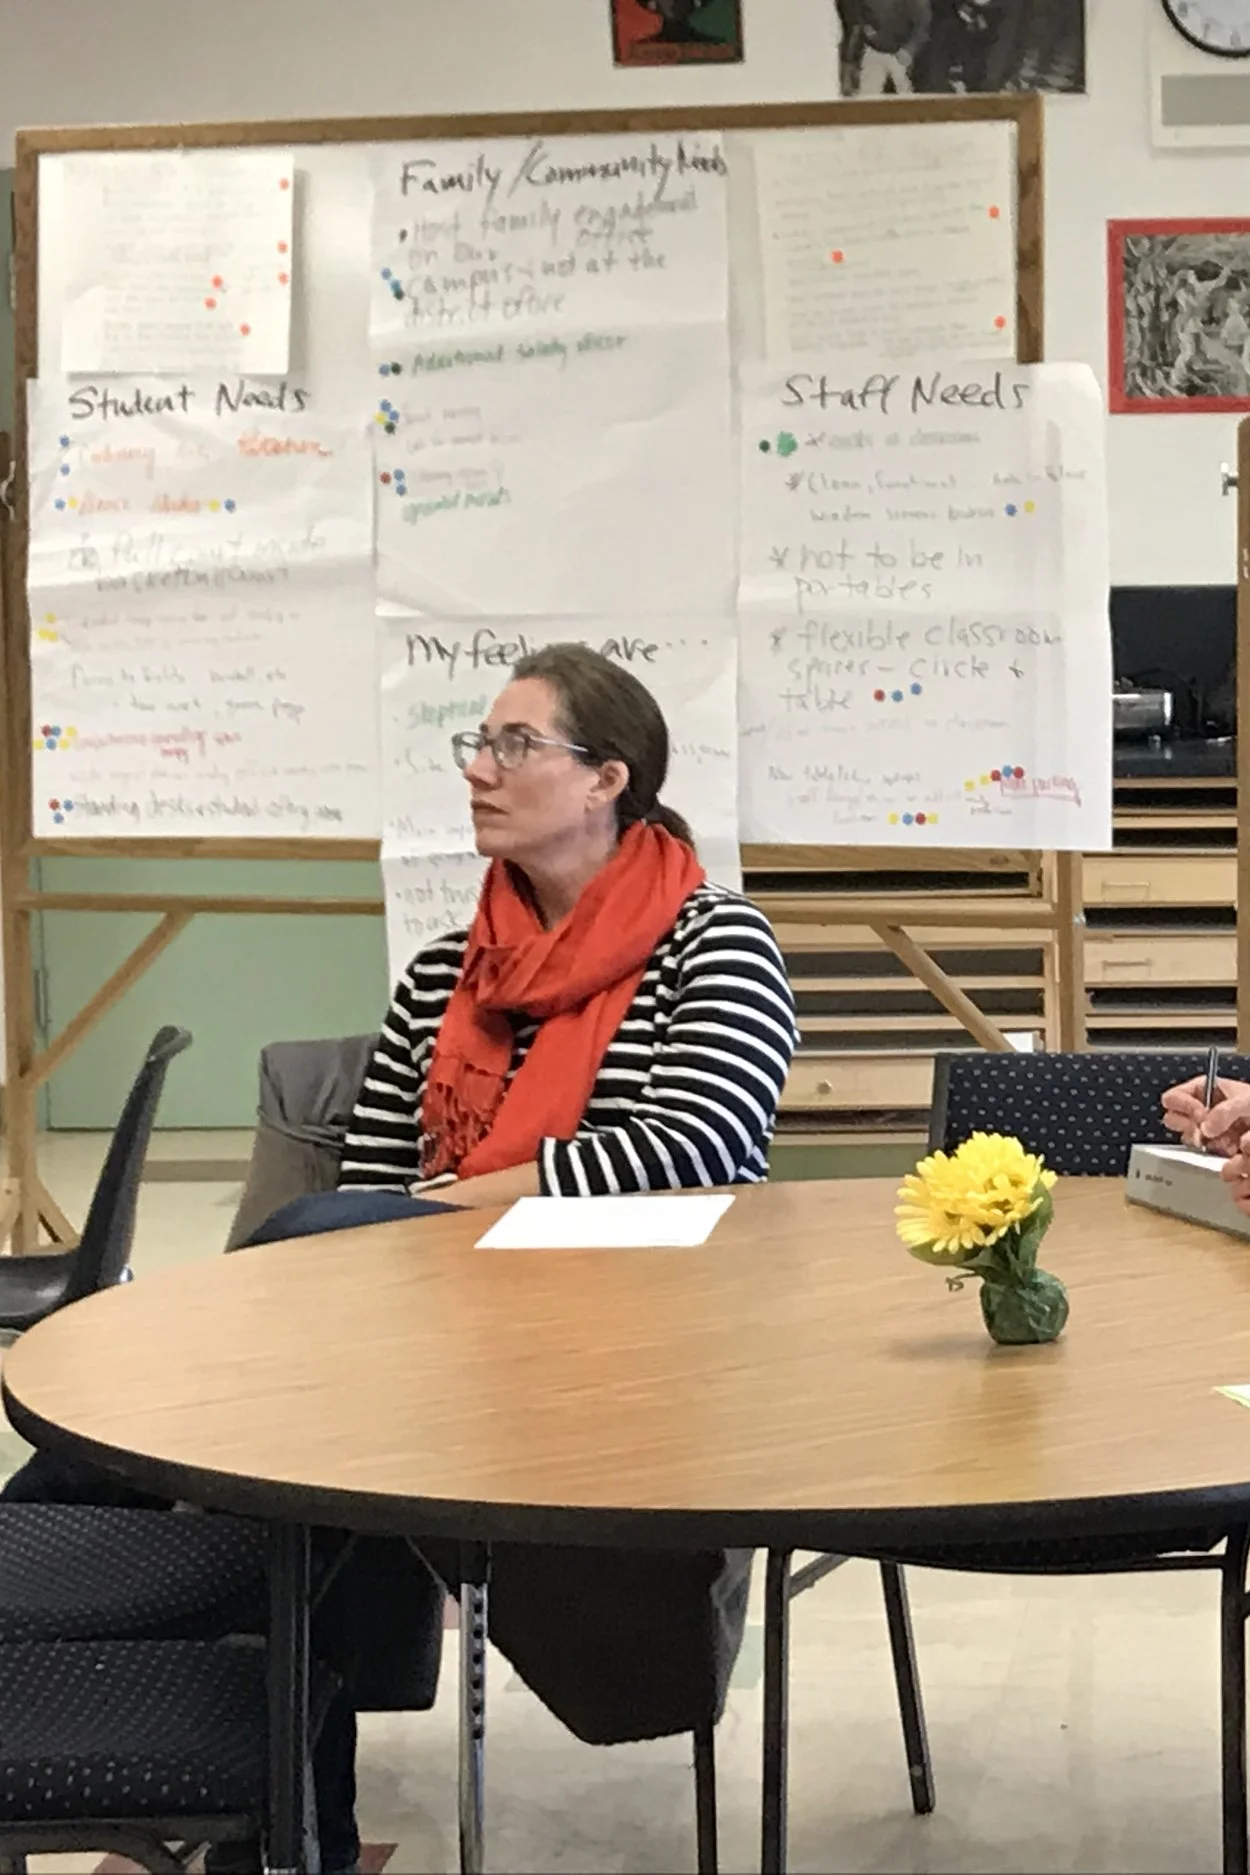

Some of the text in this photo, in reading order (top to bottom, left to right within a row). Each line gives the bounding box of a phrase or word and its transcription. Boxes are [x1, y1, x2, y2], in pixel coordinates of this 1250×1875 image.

[69, 379, 311, 420] Student Needs
[782, 371, 1029, 414] Staff Needs
[865, 541, 898, 569] to
[910, 537, 945, 570] be
[797, 618, 912, 652] flexible
